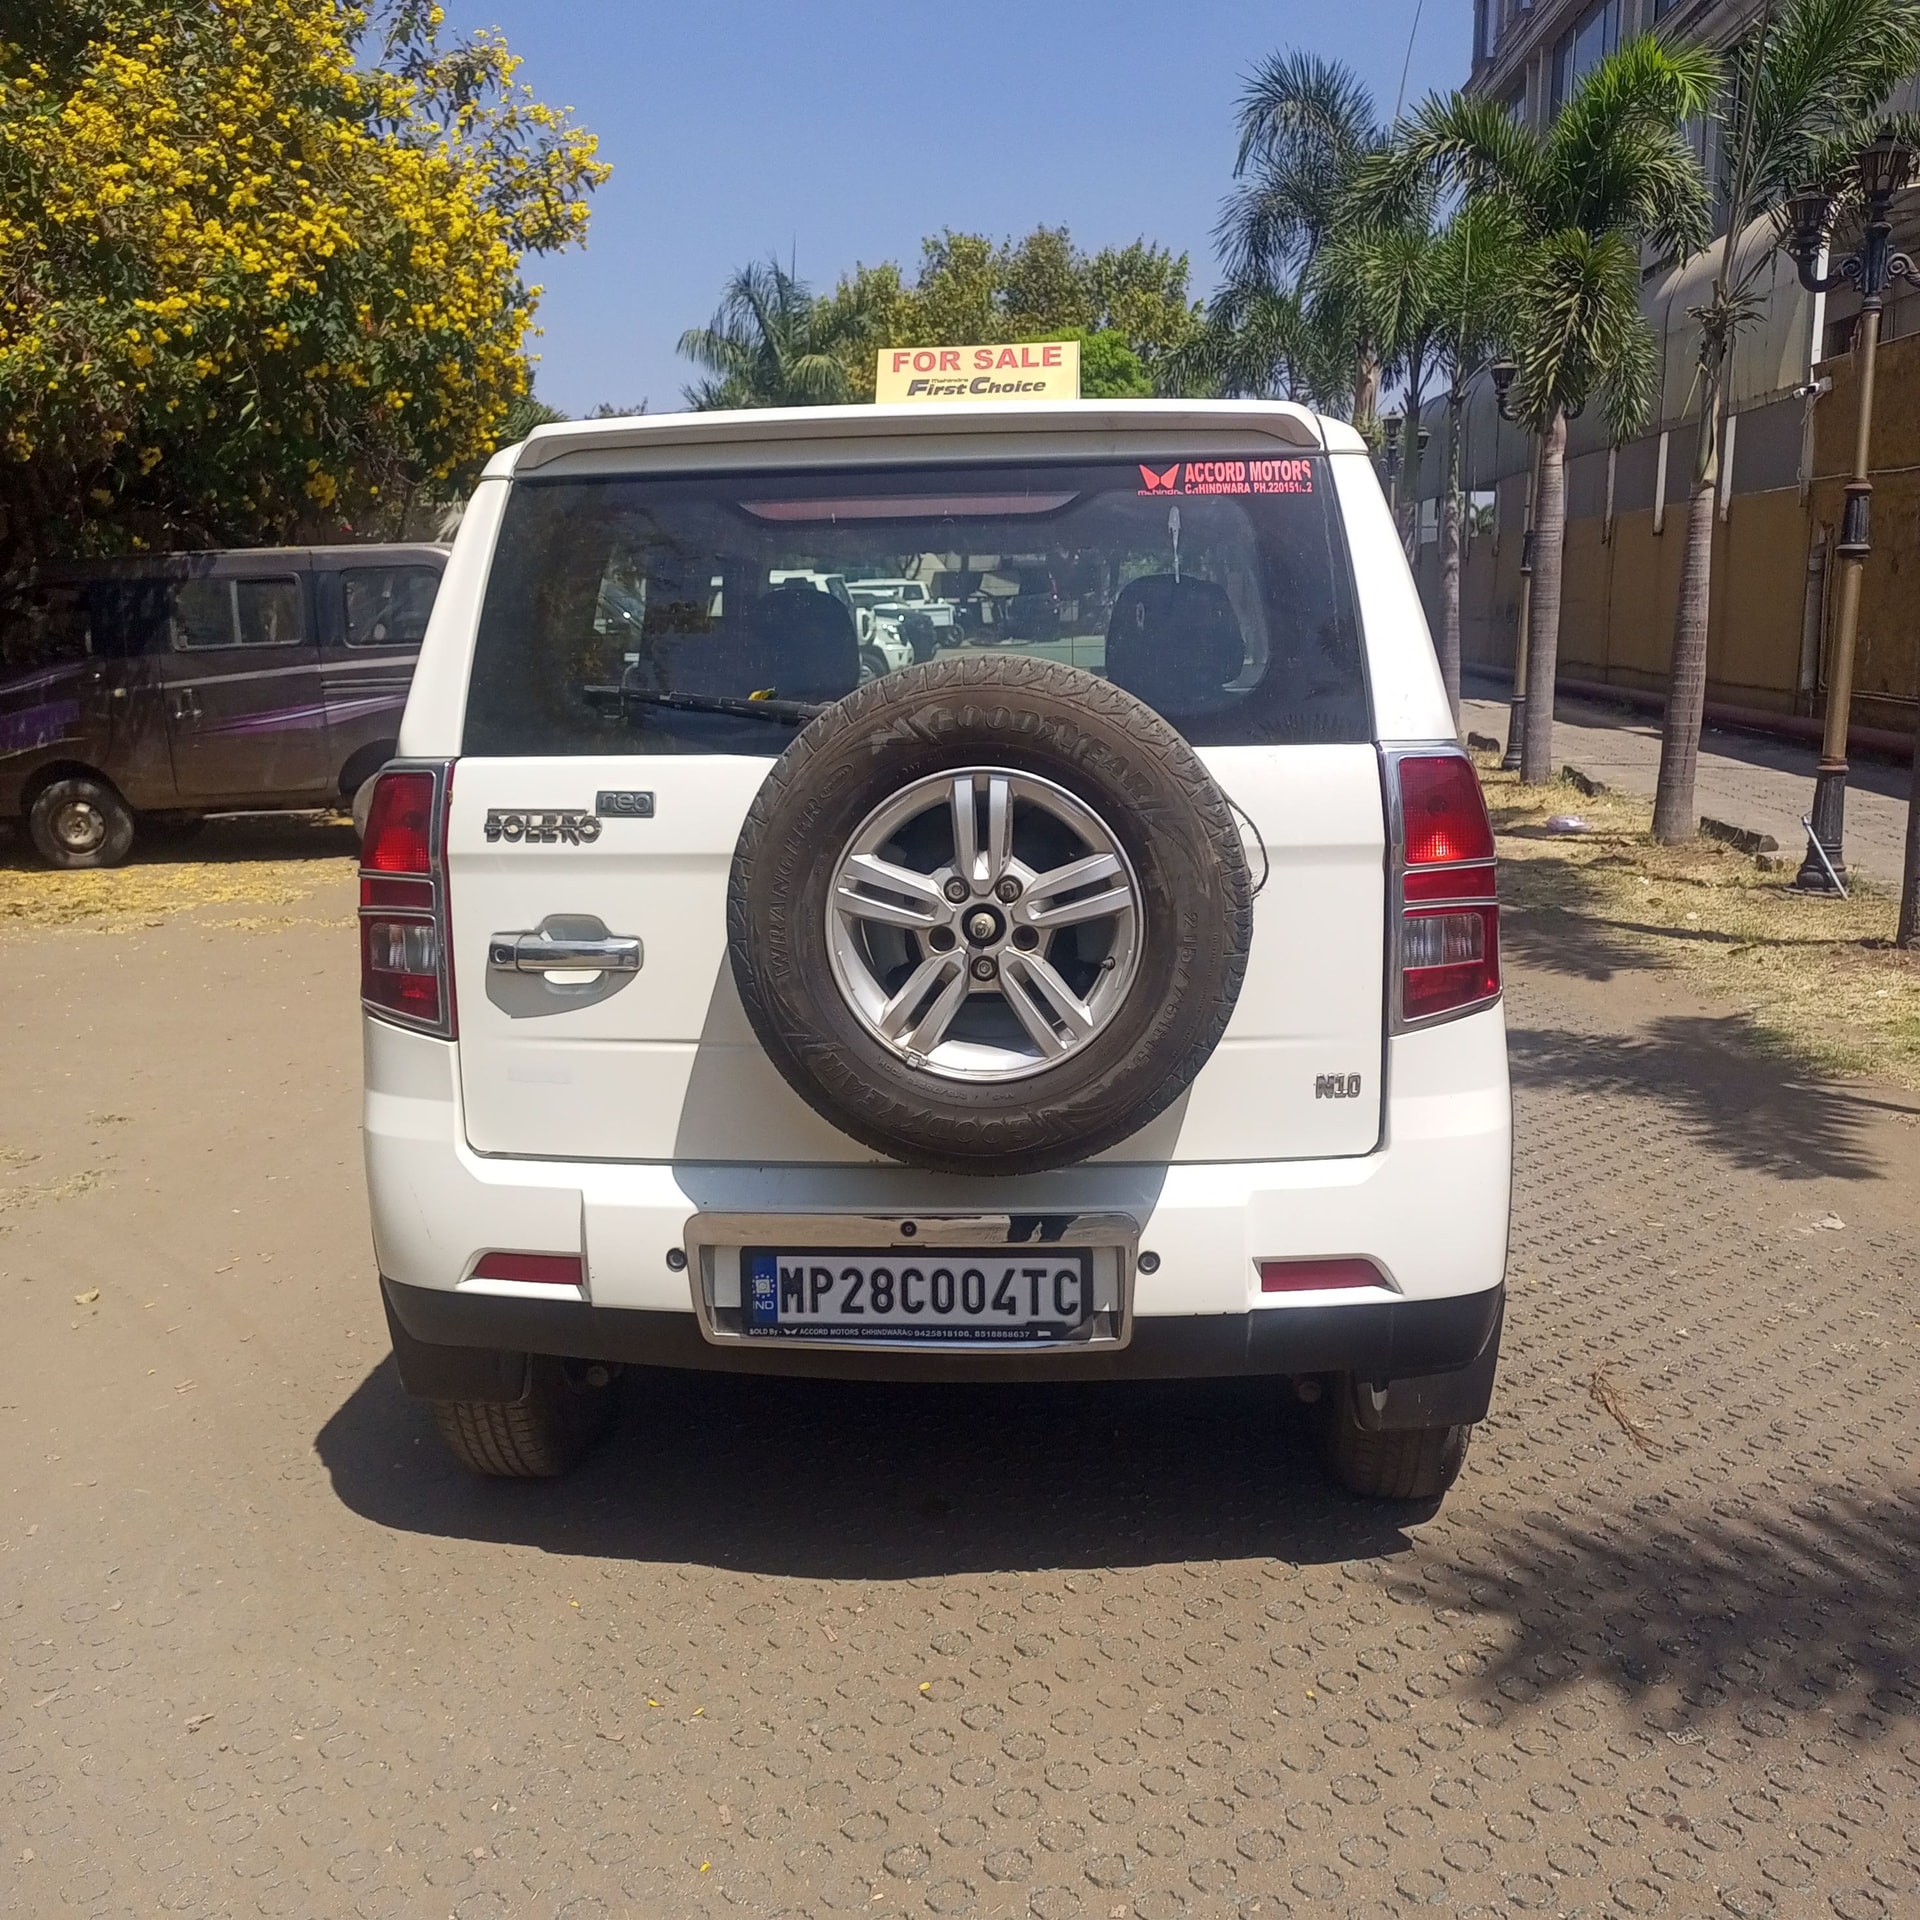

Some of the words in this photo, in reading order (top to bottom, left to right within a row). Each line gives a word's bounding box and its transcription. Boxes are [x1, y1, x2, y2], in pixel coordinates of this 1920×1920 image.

[892, 351, 961, 373] FOR
[974, 346, 1062, 370] SALE
[907, 379, 969, 396] First
[969, 376, 1046, 394] Choice
[1184, 461, 1246, 483] ACCORD
[1249, 460, 1312, 481] MOTORS
[600, 792, 652, 814] neo
[484, 809, 603, 846] BOLERO
[769, 797, 824, 978] WRANGLER
[1315, 1072, 1361, 1099] N10
[779, 1266, 1079, 1316] MP28C004TC
[800, 1328, 829, 1336] ACCORD
[830, 1328, 859, 1336] MOTORS
[861, 1328, 907, 1337] CHHINDWARA
